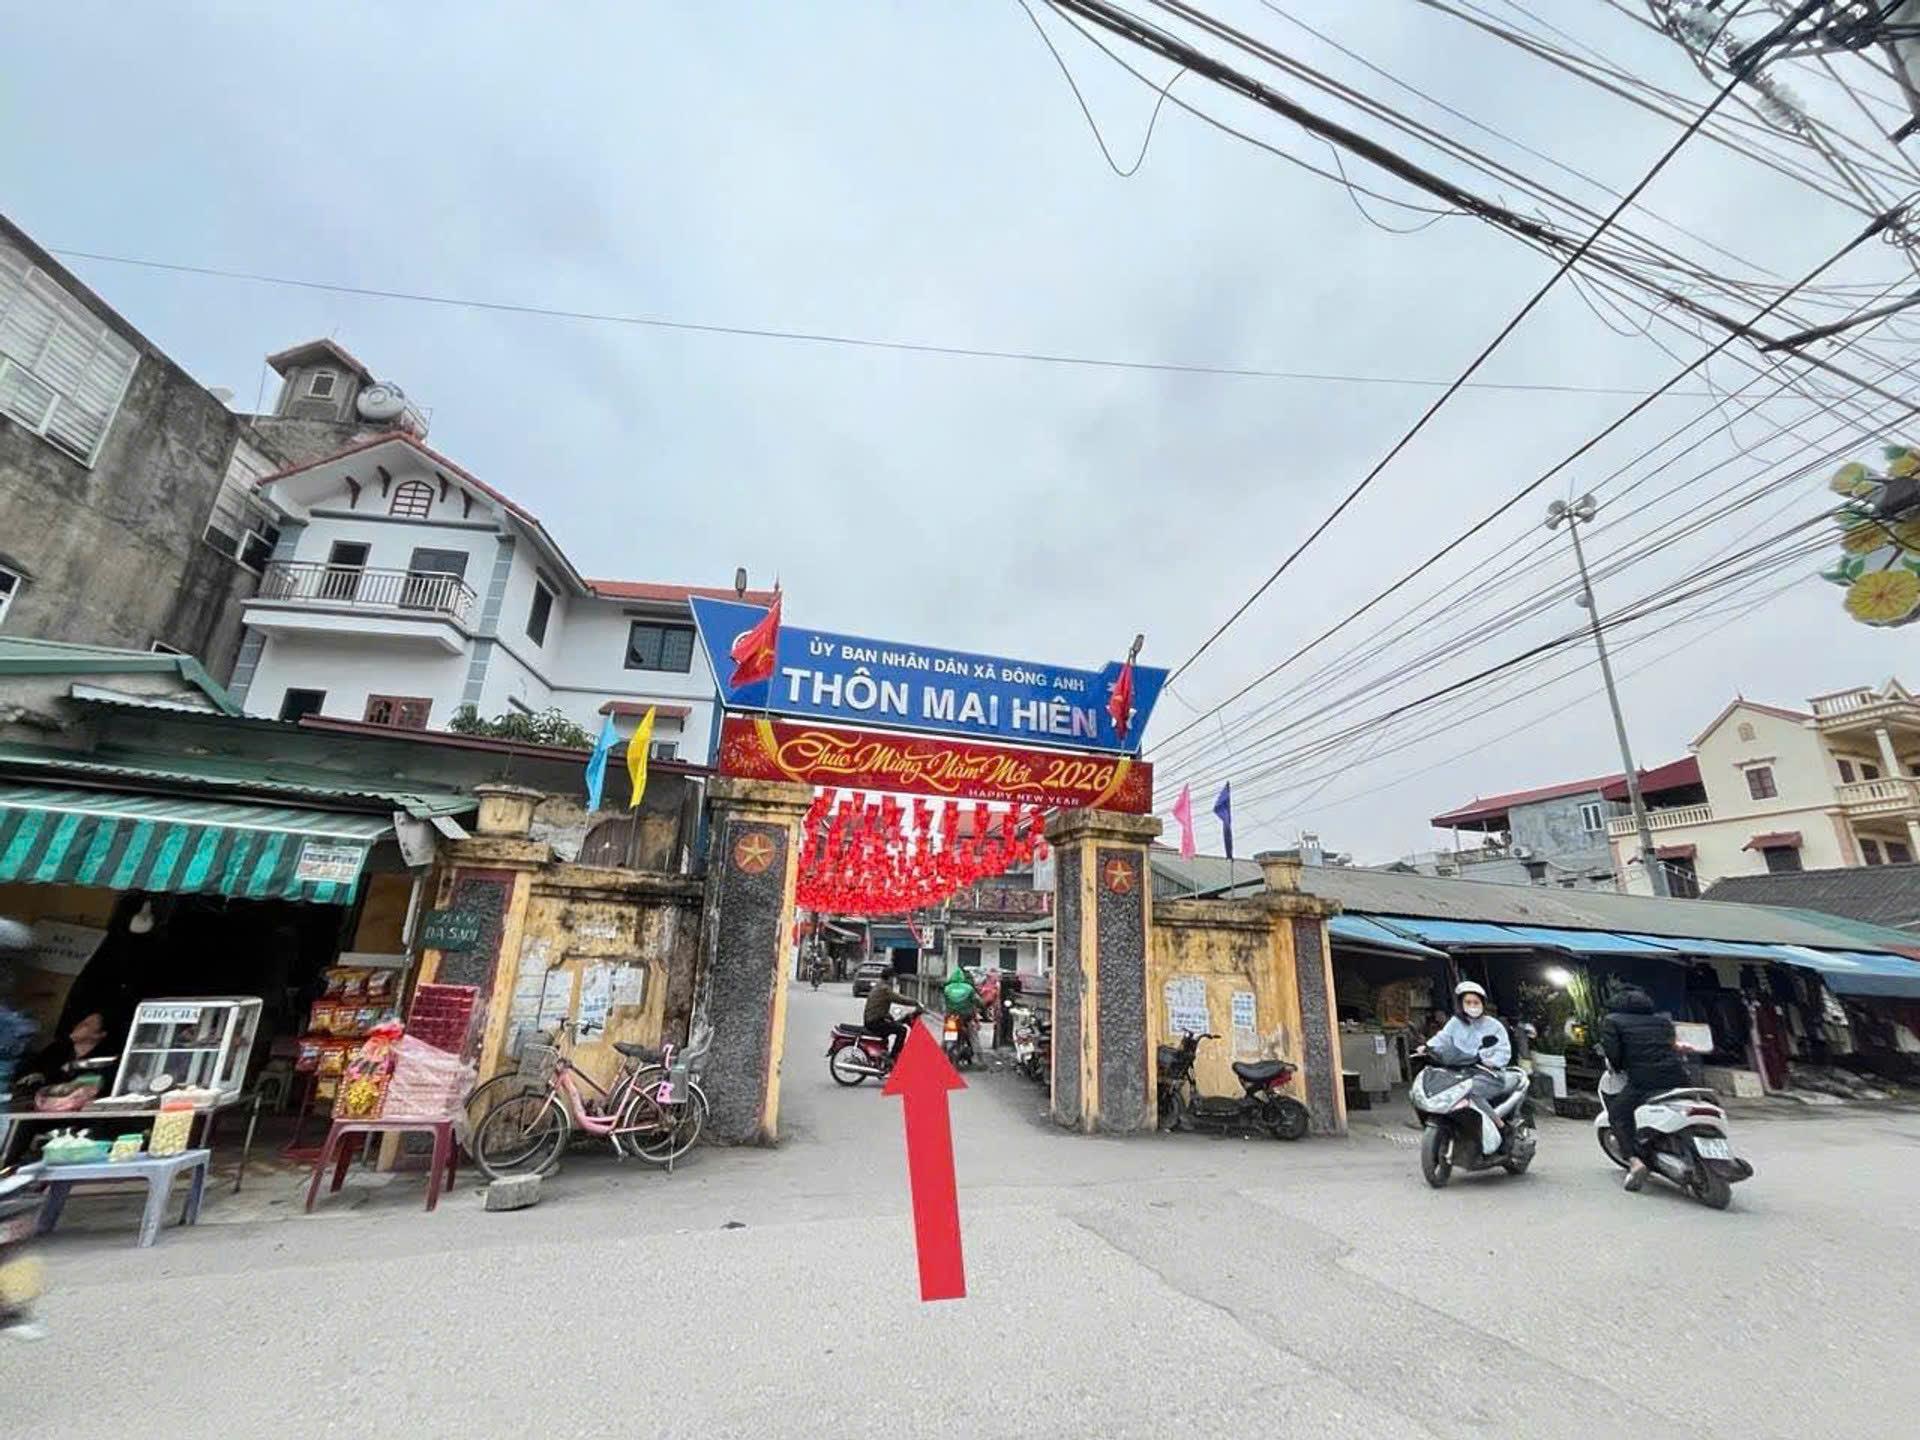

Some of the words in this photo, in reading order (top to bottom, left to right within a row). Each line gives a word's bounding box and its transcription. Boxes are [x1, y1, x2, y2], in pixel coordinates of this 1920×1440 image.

[810, 636, 835, 657] ỦY
[841, 646, 877, 663] BAN
[882, 652, 929, 671] NHÂN
[934, 657, 968, 676] DÂN
[973, 663, 996, 681] XÃ
[1001, 666, 1047, 687] ĐÔNG
[1053, 677, 1085, 692] ANH
[782, 666, 909, 715] THÔN
[922, 686, 999, 727] MAI
[1012, 695, 1098, 738] HIÊN
[777, 732, 860, 773] Chúc
[838, 742, 924, 784] Mừng
[918, 748, 979, 790] Năm
[976, 754, 1034, 788] Mới
[1041, 760, 1114, 792] 2026
[968, 788, 1011, 800] HAPPY
[1017, 793, 1043, 803] NEW
[1048, 796, 1079, 806] YEAR
